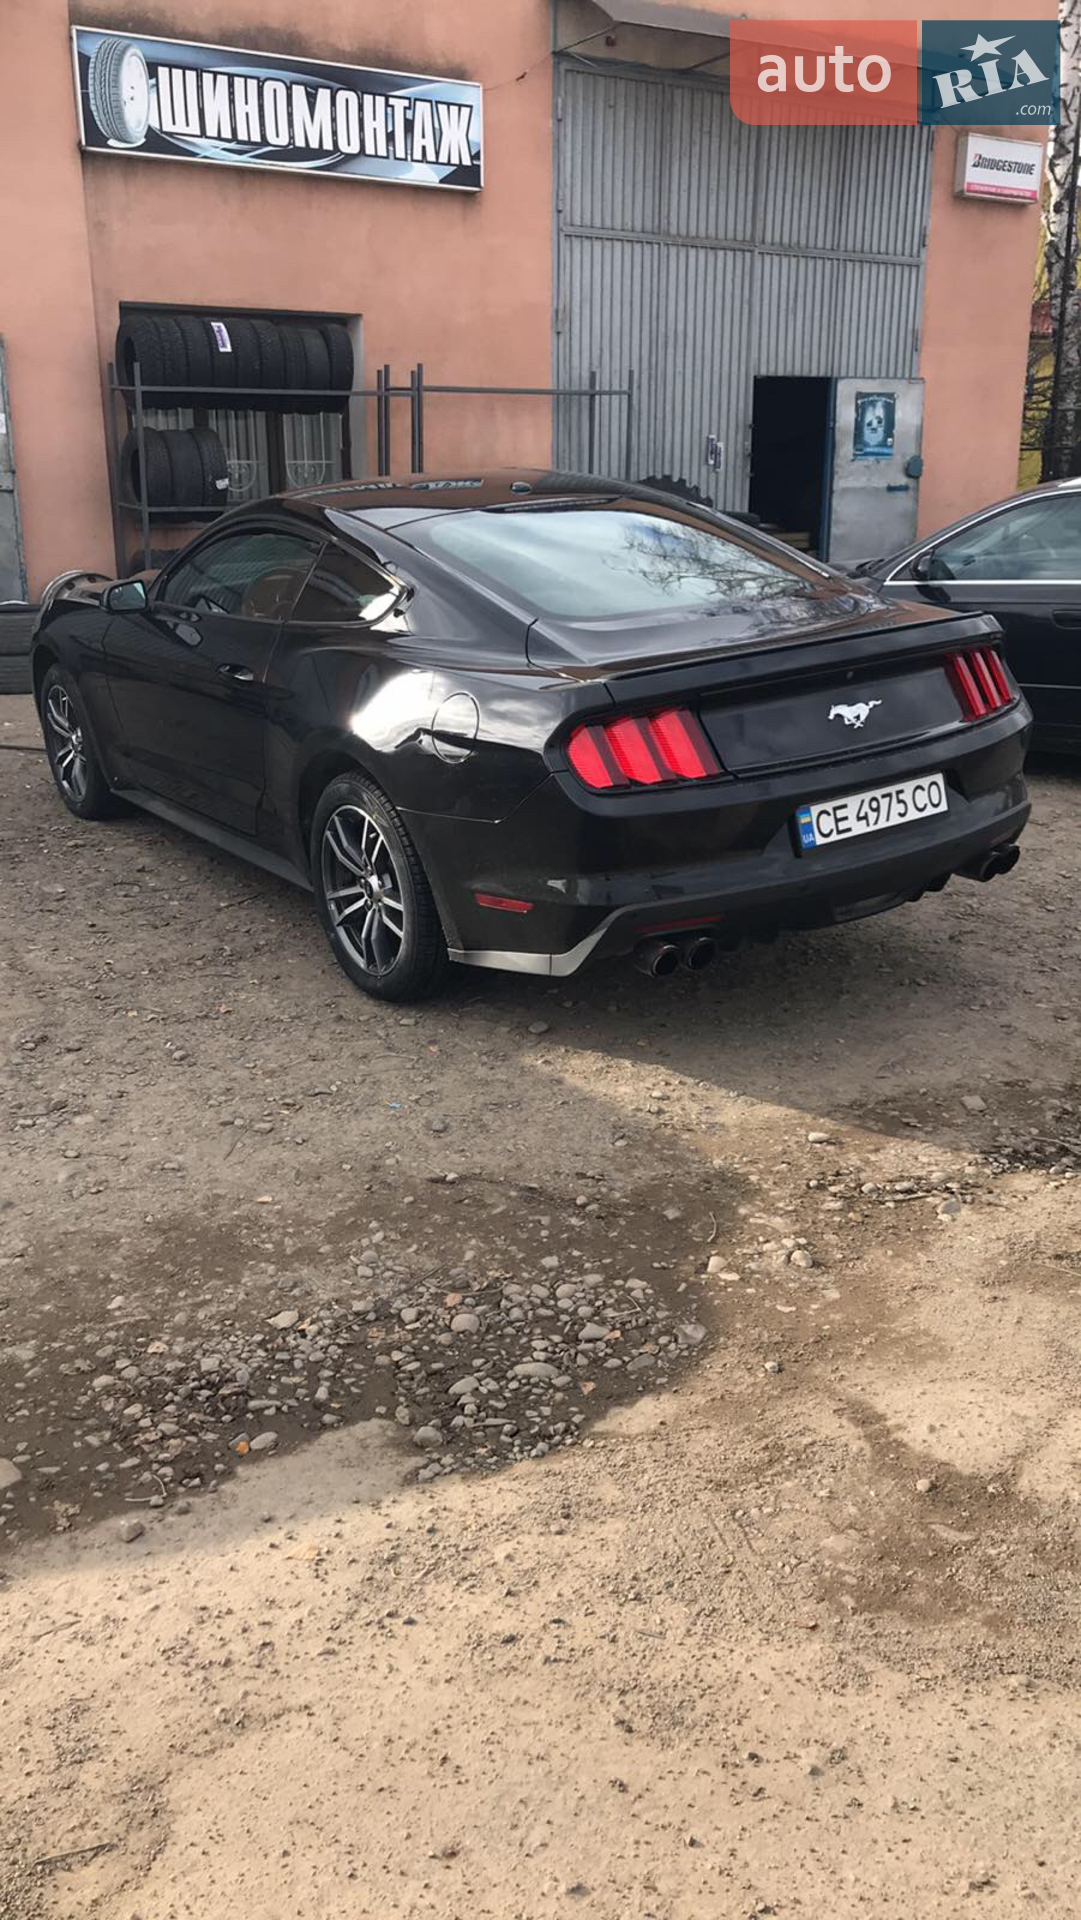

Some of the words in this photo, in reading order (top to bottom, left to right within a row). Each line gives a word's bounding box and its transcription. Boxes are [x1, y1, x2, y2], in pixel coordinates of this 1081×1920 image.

[157, 66, 474, 166] ШИНОМОНТАЖ
[971, 153, 1036, 176] BRIDGESTONE
[816, 803, 852, 838] CE
[856, 789, 909, 828] 4975
[912, 780, 942, 813] CO
[802, 833, 815, 844] UA
